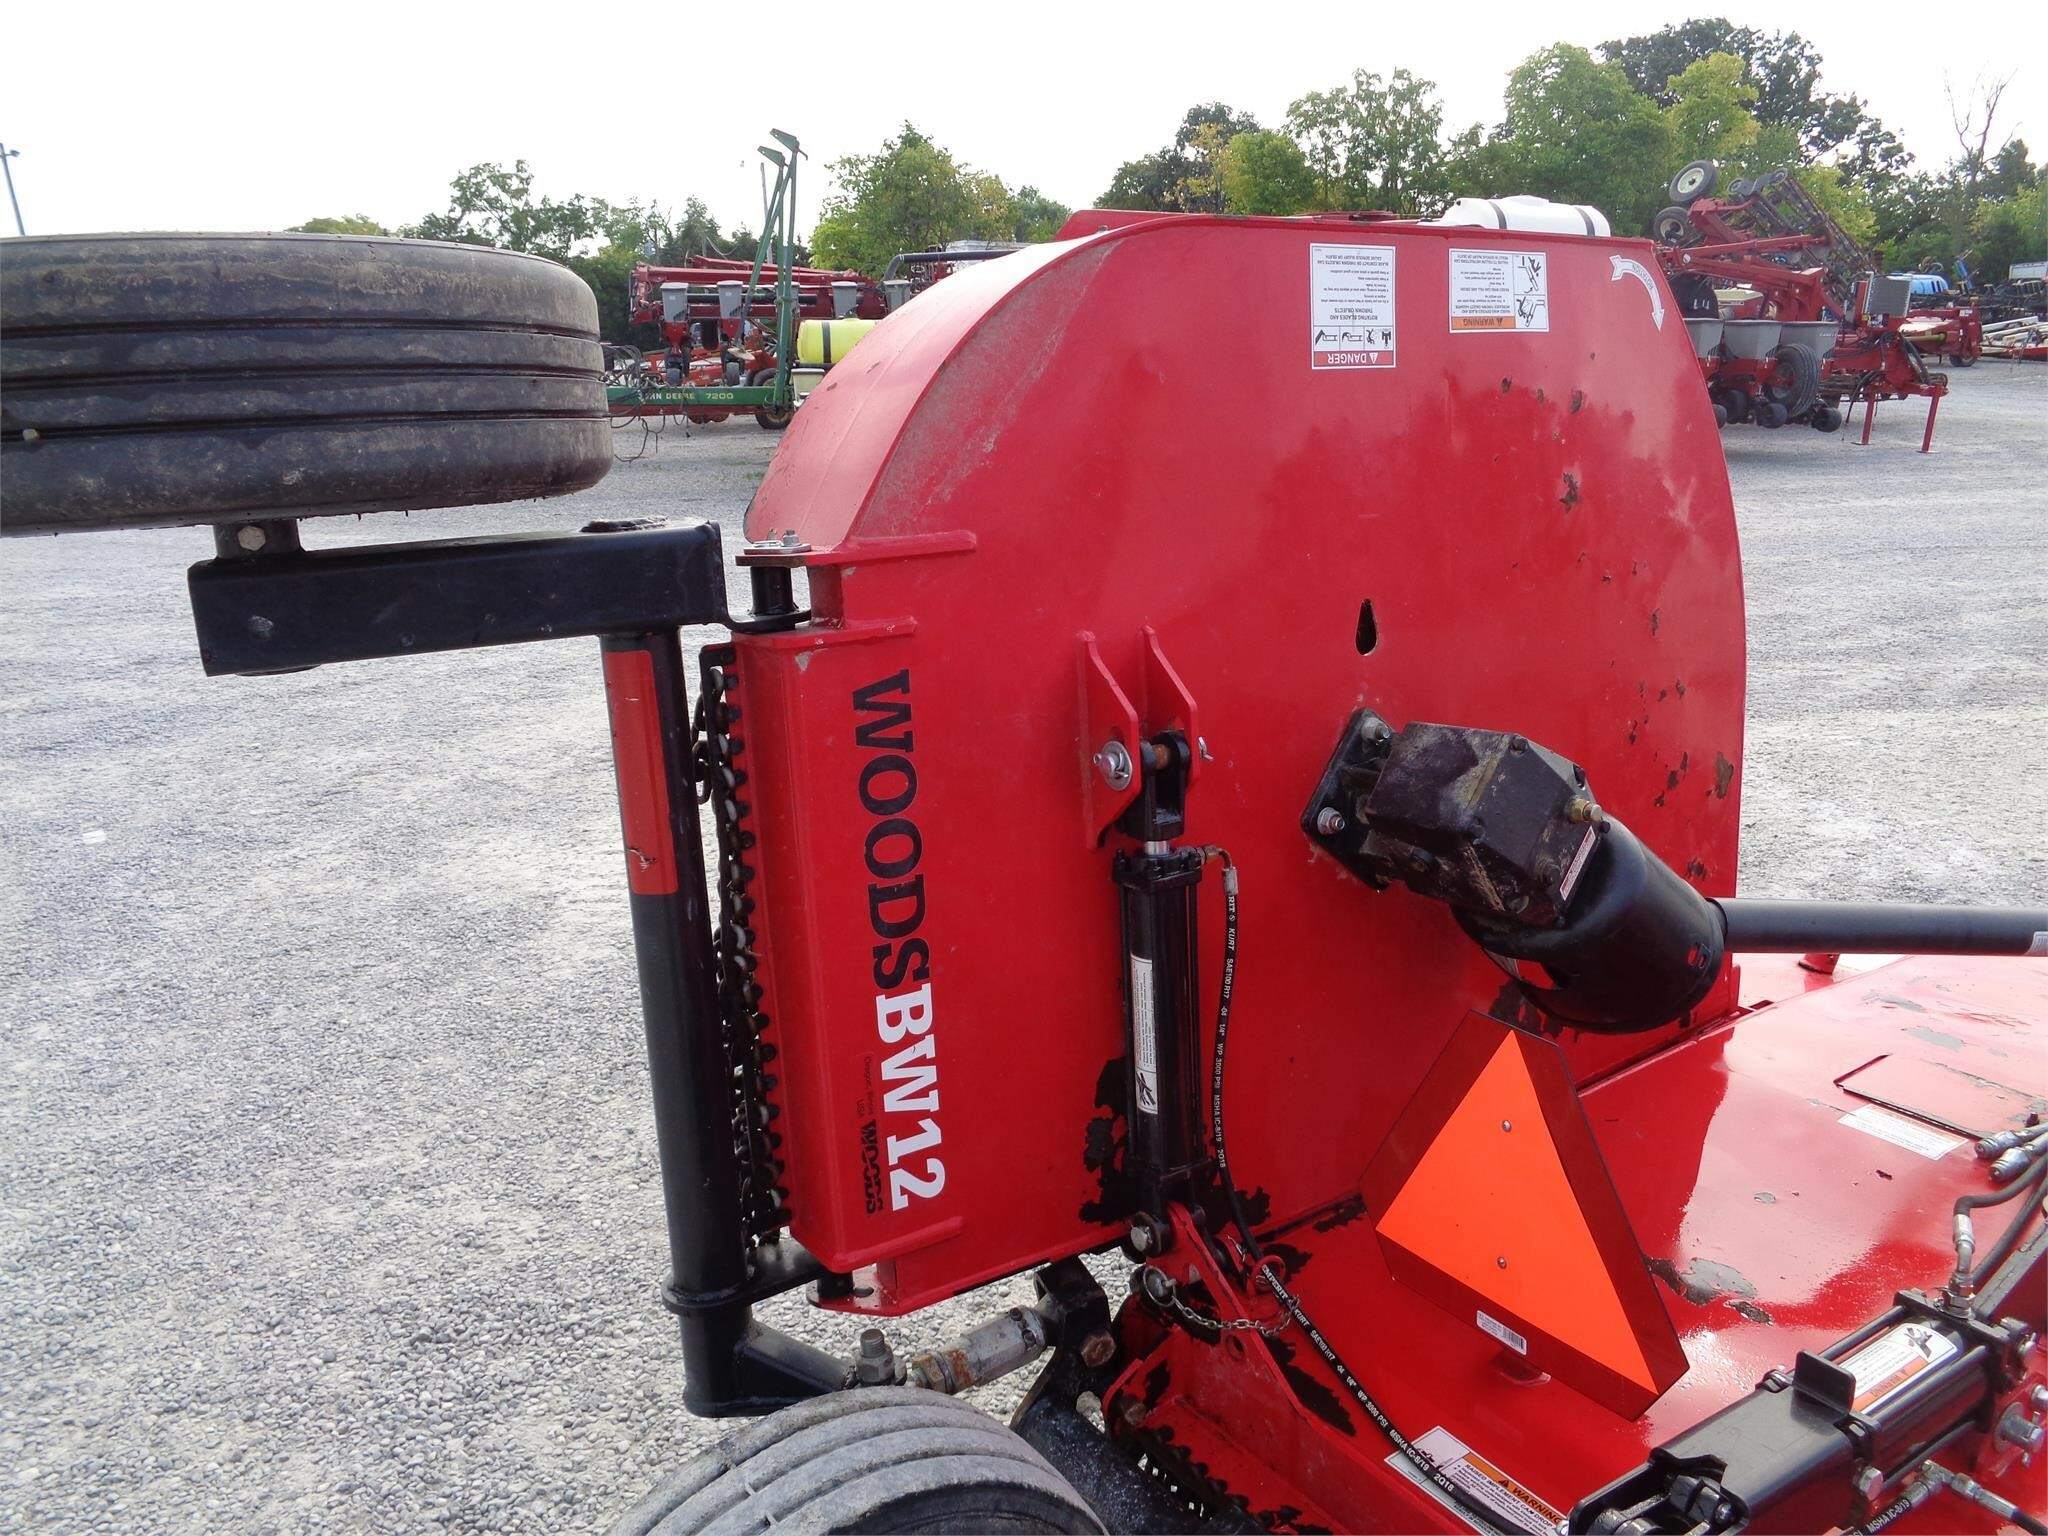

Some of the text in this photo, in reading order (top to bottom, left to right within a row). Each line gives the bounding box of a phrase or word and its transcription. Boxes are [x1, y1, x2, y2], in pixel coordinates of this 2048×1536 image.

[1328, 352, 1367, 364] DANGER
[1225, 958, 1233, 985] SAE100
[1216, 1043, 1224, 1055] WP
[860, 1120, 884, 1214] WOODS
[1294, 1308, 1310, 1327] KURT
[1389, 1428, 1407, 1451] MSHA
[1434, 1472, 1455, 1492] 2Q18
[1465, 1464, 1488, 1480] RAISED
[1486, 1477, 1521, 1504] IMPLEMENT
[1532, 1512, 1552, 1527] DROP
[1866, 1514, 1890, 1533] MSHA
